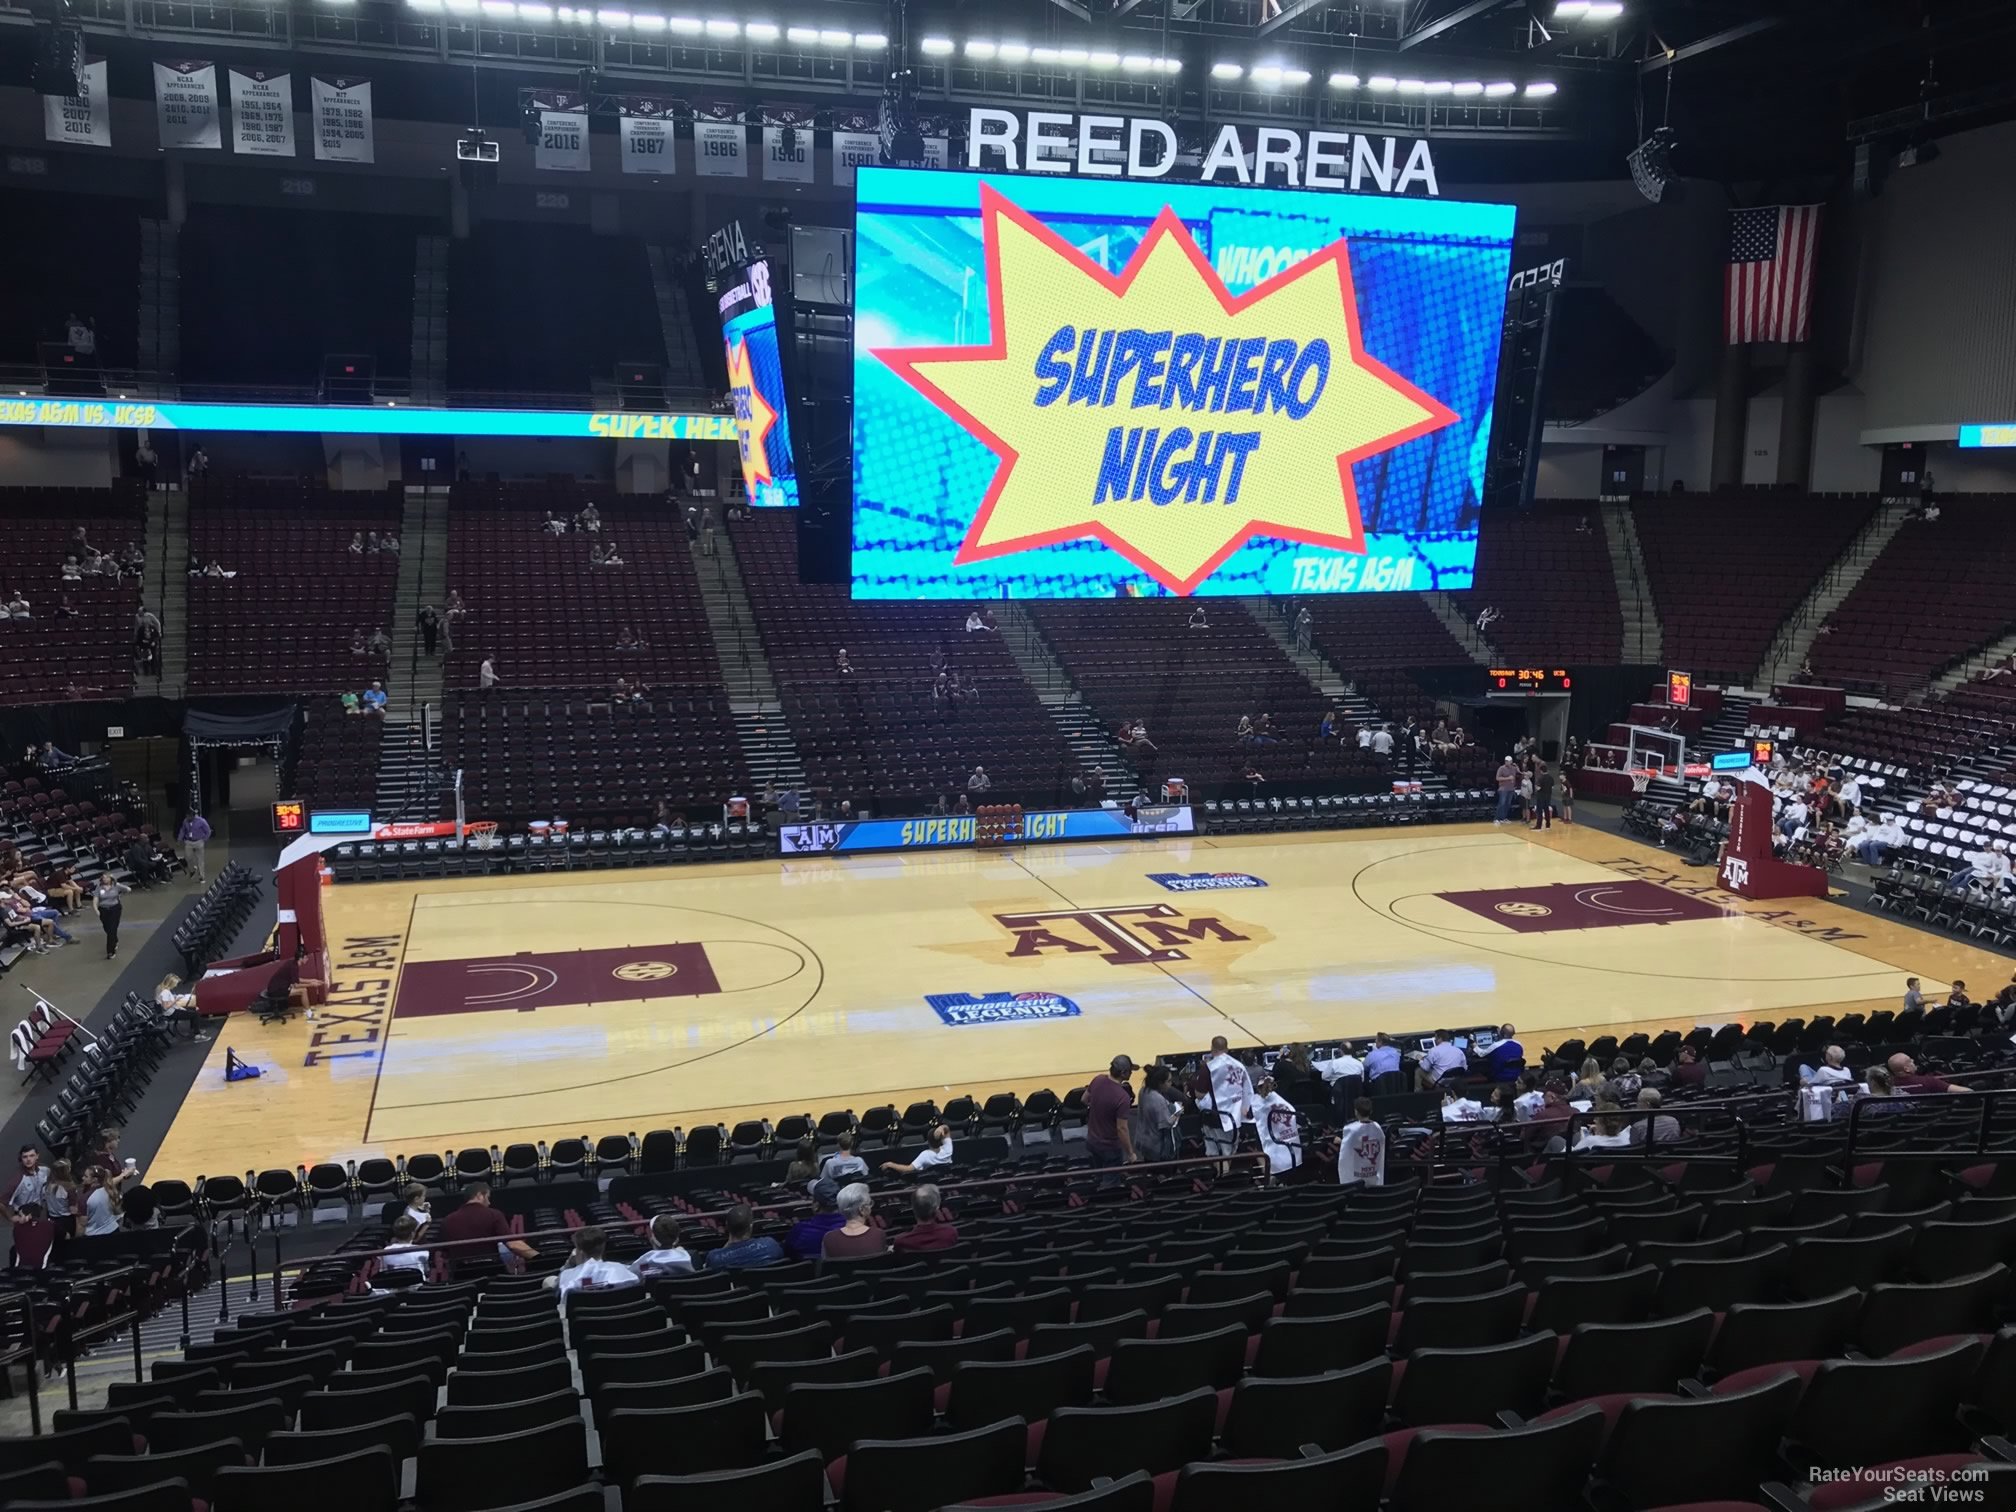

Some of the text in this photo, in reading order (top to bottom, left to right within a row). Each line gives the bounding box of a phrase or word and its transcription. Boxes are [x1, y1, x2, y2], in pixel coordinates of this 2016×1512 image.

[188, 94, 210, 103] 2009
[63, 108, 91, 121] 2007
[166, 115, 188, 125] 2016
[65, 121, 92, 134] 2016
[344, 130, 365, 140] 2005
[266, 134, 286, 144] 2007
[544, 133, 580, 150] 2016
[630, 138, 665, 154] 1987
[704, 141, 738, 157] 1986
[969, 108, 1440, 196] REED ARENA
[537, 193, 569, 209] 220
[1032, 324, 1332, 421] SUPERHERO
[0, 402, 35, 423] EXAS
[40, 402, 79, 424] A&M
[115, 406, 156, 425] UCSB
[588, 414, 738, 440] SUPER HER
[1092, 425, 1262, 507] NIGHT
[1291, 556, 1416, 592] TEXAS A&M
[1498, 677, 1506, 688] 0
[1563, 677, 1571, 688] 0
[1518, 669, 1545, 680] 30:46
[1673, 685, 1687, 703] 30
[1756, 750, 1769, 761] 30
[281, 815, 298, 827] 30
[901, 814, 1068, 846] SUPERH IGHT
[303, 933, 402, 1068] TEXAS A&M
[947, 998, 1060, 1013] PROGRESSIVE
[950, 1003, 1068, 1022] LEGENDS
